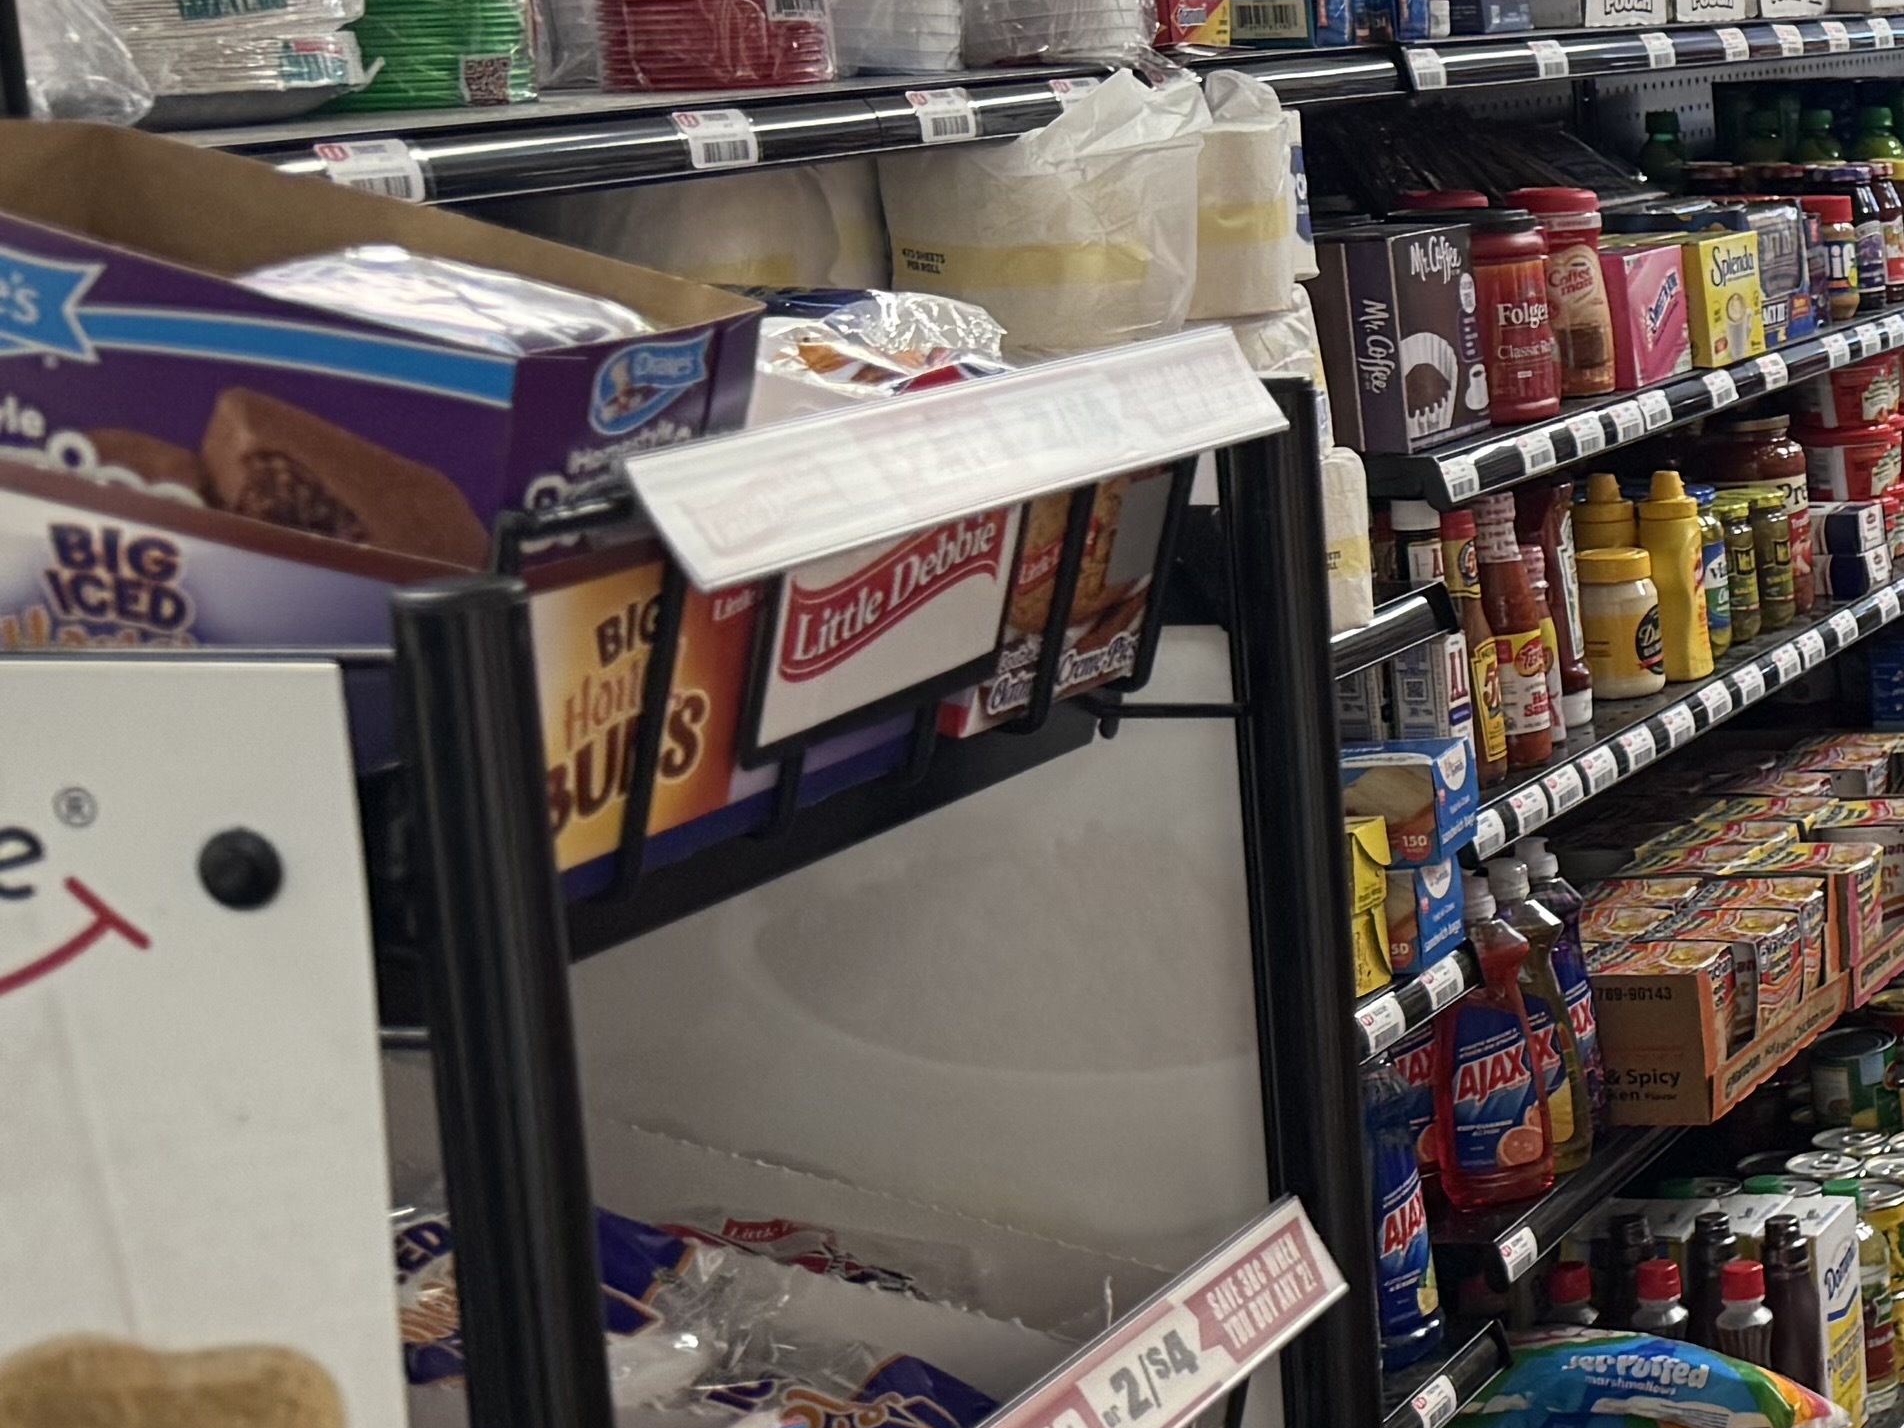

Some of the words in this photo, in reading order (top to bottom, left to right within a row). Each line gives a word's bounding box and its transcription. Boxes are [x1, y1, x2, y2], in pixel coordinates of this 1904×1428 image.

[1549, 265, 1594, 291] Coffee
[1709, 244, 1754, 290] Splenda
[1498, 342, 1532, 360] Classic
[49, 522, 183, 580] BIG
[892, 517, 996, 615] Debbie
[46, 572, 189, 629] ICED
[793, 594, 881, 663] Little
[1402, 834, 1428, 849] 150
[1456, 1037, 1531, 1104] AJAX
[1625, 1068, 1681, 1088] Spicy
[1206, 1278, 1244, 1320] SAVE
[1264, 1232, 1301, 1282] WHEN
[1221, 1314, 1252, 1352] YOU
[1250, 1294, 1278, 1333] BUY
[1273, 1277, 1303, 1319] ANY
[1102, 1404, 1121, 1428] or
